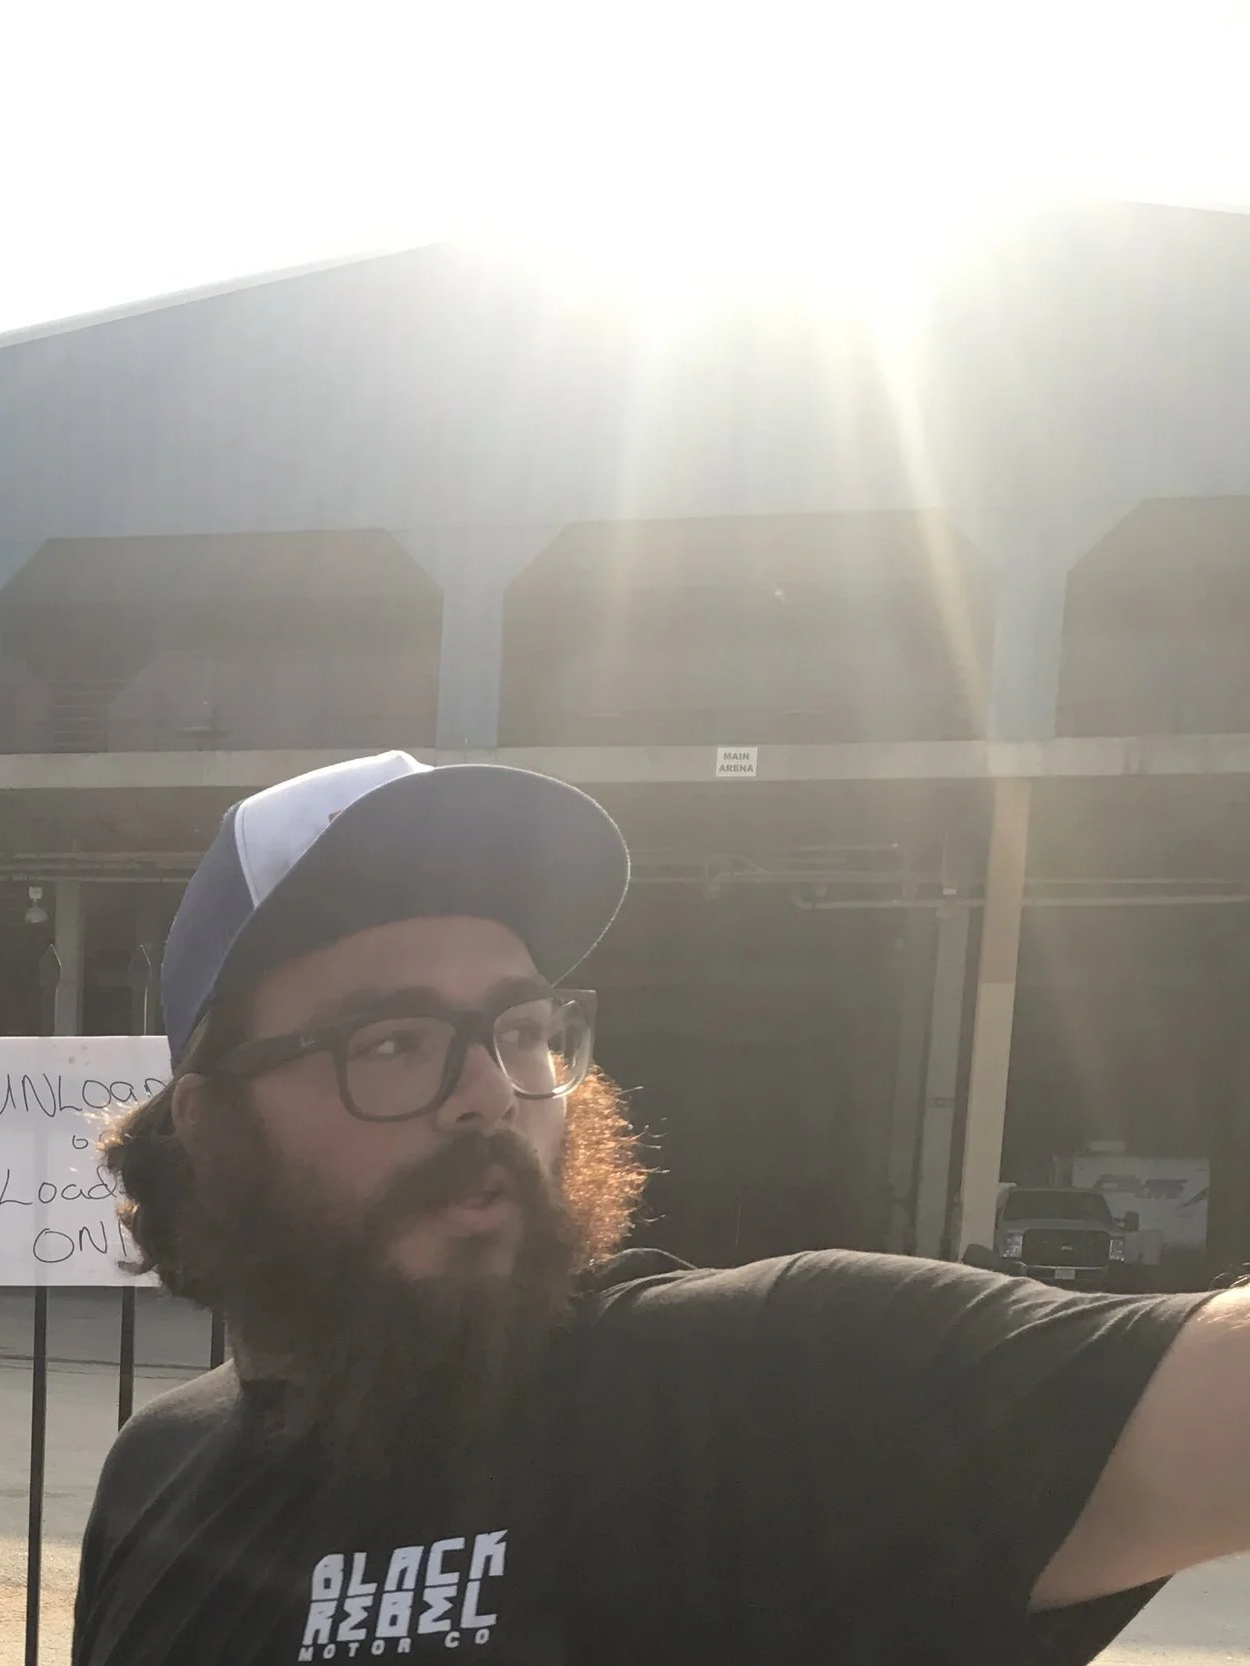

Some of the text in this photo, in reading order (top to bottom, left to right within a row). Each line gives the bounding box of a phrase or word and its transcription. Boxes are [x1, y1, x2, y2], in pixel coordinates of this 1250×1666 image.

[719, 764, 754, 772] ARENA
[723, 752, 750, 760] MAIN
[311, 1529, 508, 1601] BLACK
[302, 1580, 498, 1646] REBEL
[298, 1628, 490, 1662] MOTOR CO
